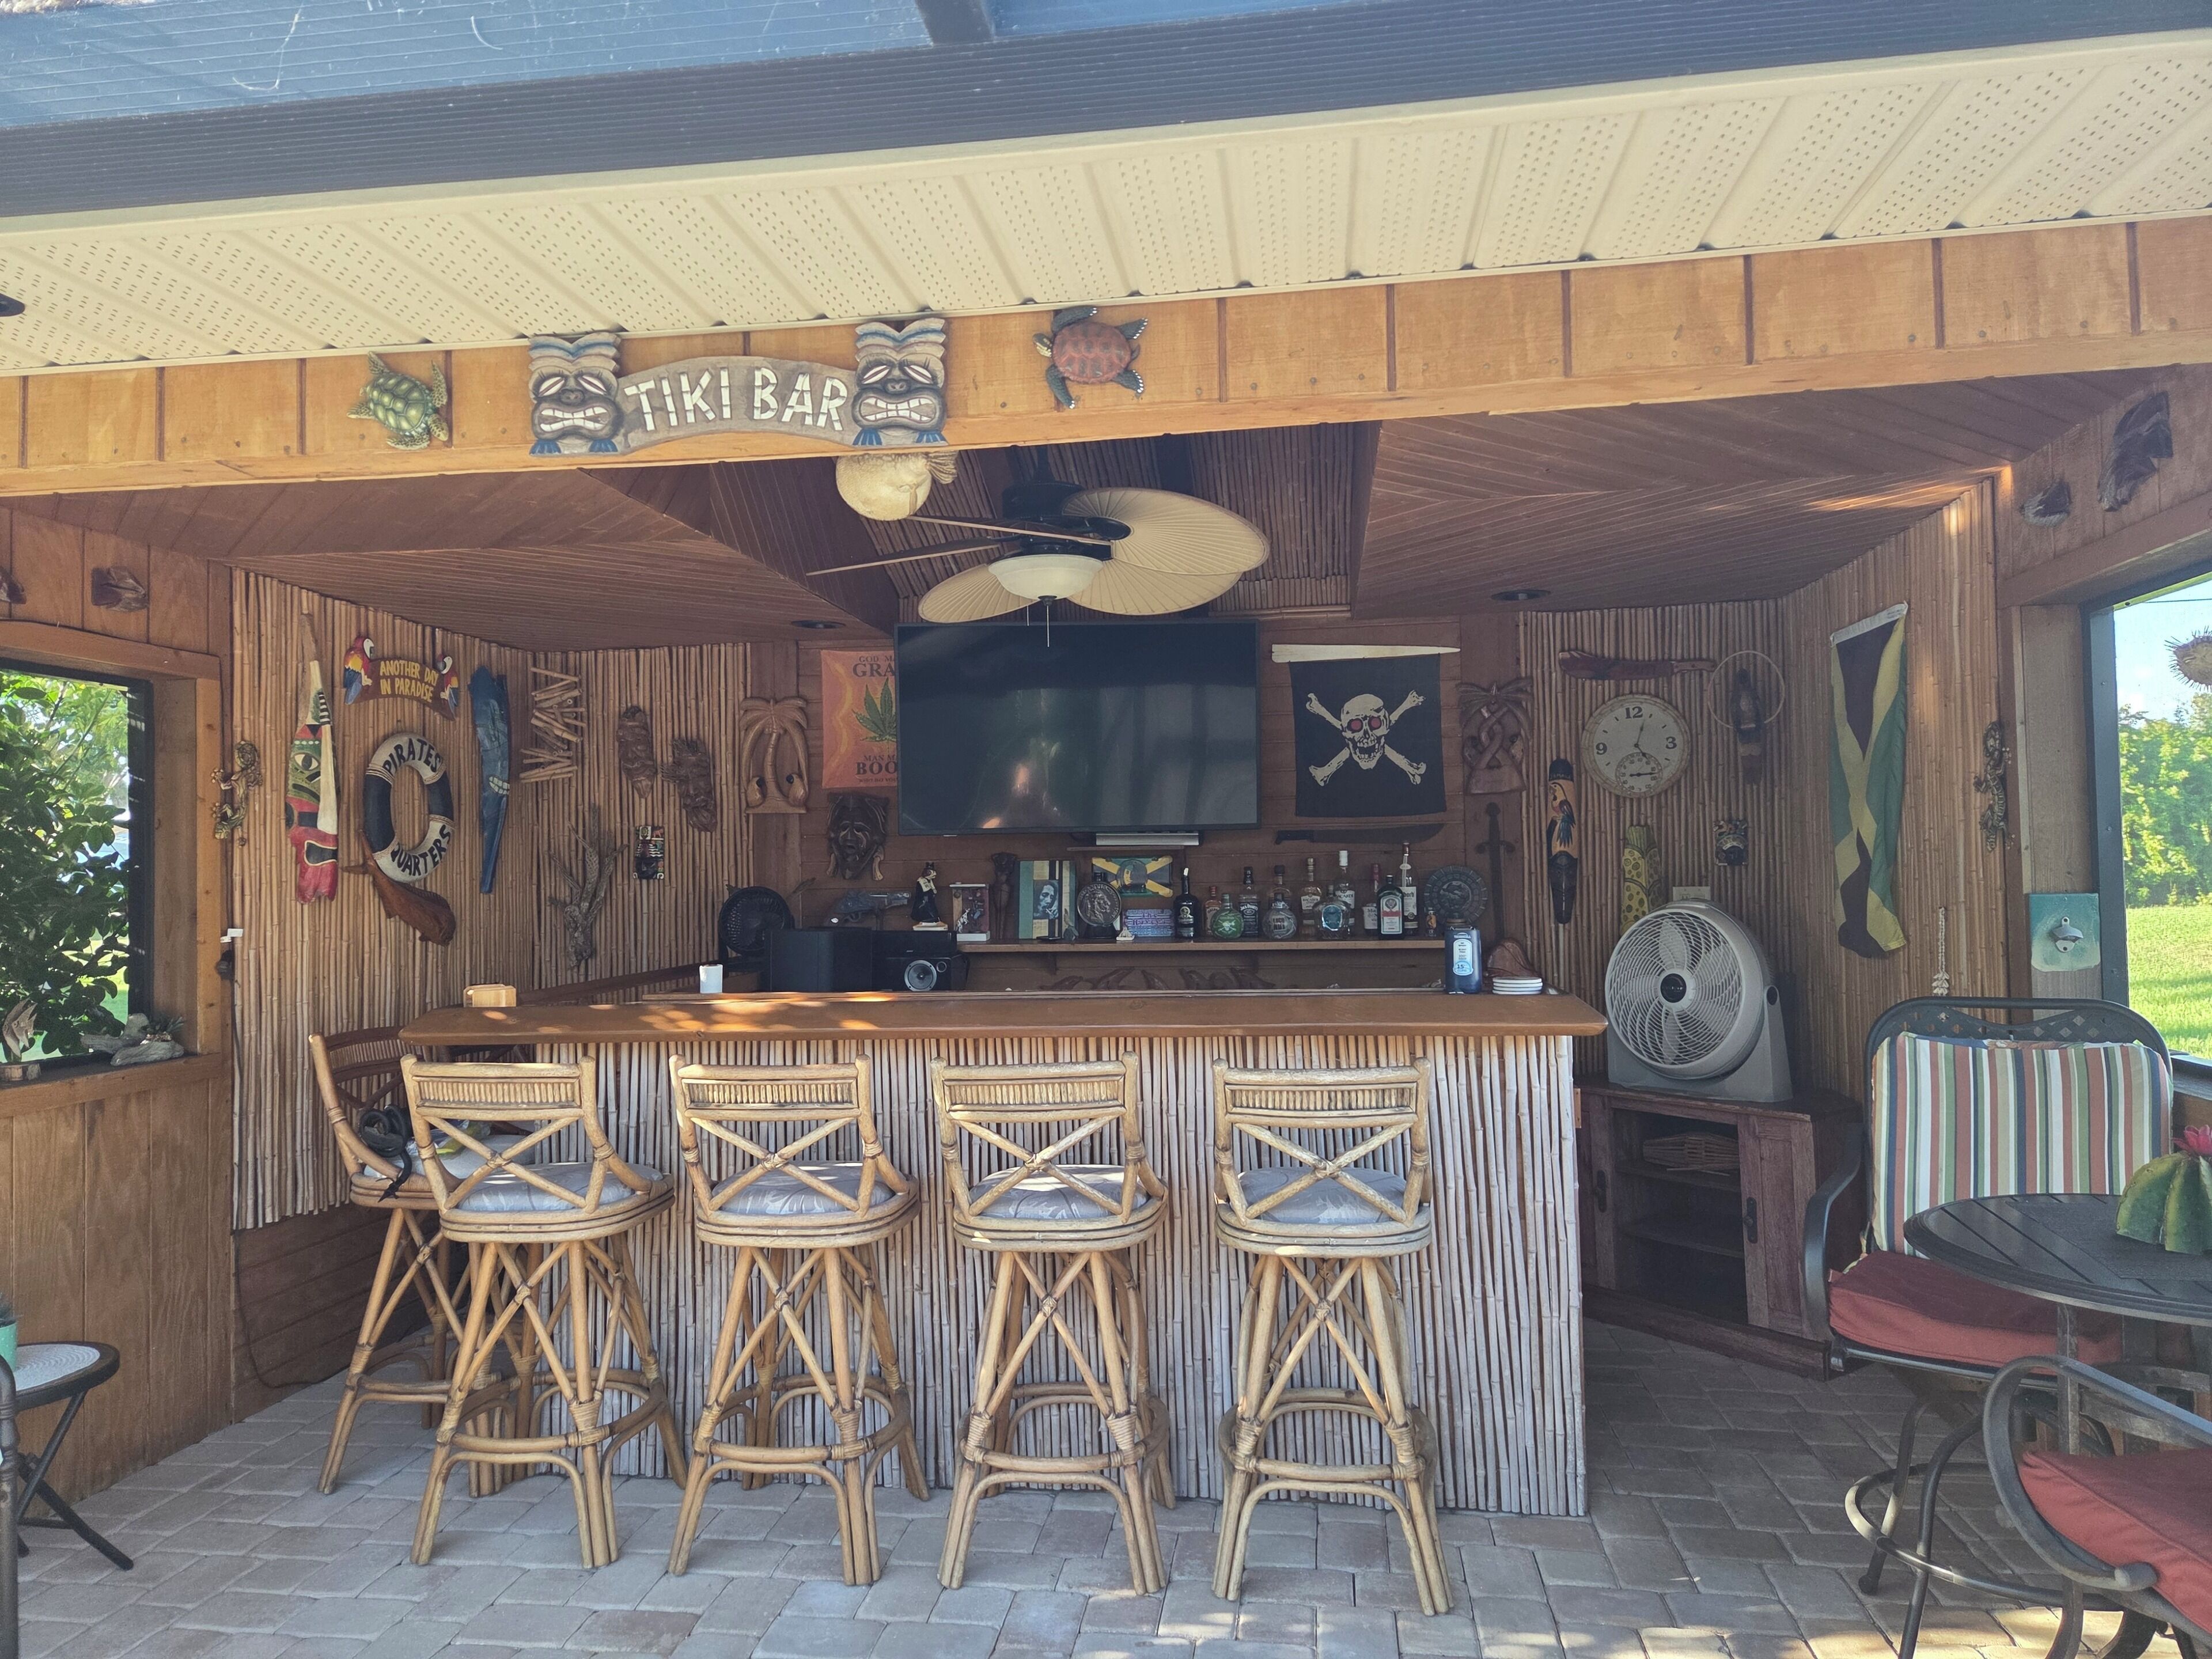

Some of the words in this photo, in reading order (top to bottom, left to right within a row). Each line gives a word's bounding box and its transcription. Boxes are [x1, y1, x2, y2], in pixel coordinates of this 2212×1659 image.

[624, 367, 732, 432] TIKI
[752, 366, 848, 431] BAR
[379, 660, 421, 679] ANOTHER
[424, 666, 439, 686] DAY
[380, 678, 392, 695] IN
[395, 677, 434, 703] PARADISE
[1624, 706, 1643, 719] 12
[1595, 742, 1608, 755] 9
[1665, 736, 1677, 749] 3
[382, 738, 443, 774] PIRATES
[855, 760, 897, 775] BOO
[390, 824, 451, 876] QUARTERS
